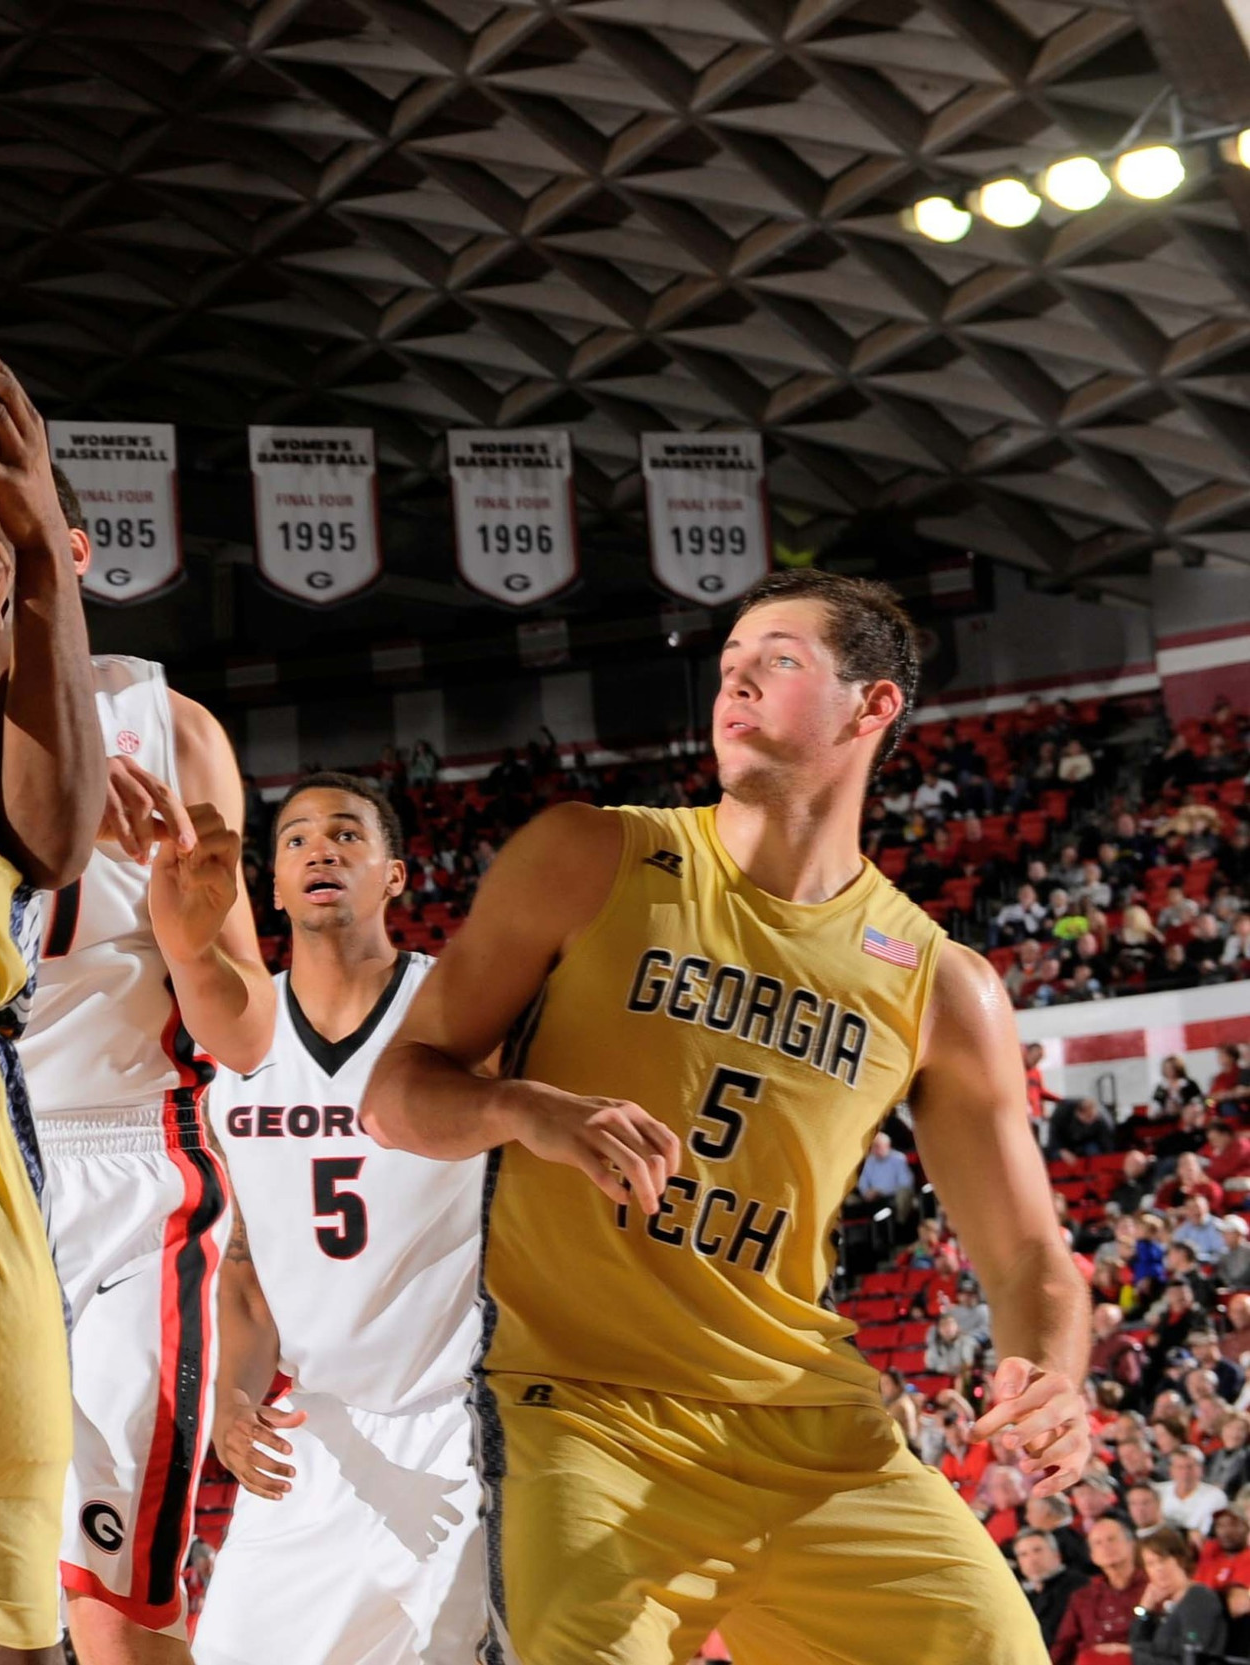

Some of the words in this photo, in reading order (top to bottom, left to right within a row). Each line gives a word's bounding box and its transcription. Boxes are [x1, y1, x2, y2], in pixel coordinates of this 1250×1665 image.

[70, 434, 152, 446] WOMEN'S
[271, 438, 352, 450] WOMEN'S
[55, 449, 168, 462] BASKETBALL
[257, 453, 368, 466] BASKETBALL
[454, 456, 563, 469] BASKETBALL
[117, 490, 153, 503] FOUR
[275, 493, 314, 507] FINAL
[318, 494, 354, 508] FOUR
[474, 496, 511, 510] FINAL
[667, 498, 705, 512] FINAL
[278, 521, 357, 552] 1995
[477, 524, 553, 554] 1996
[671, 525, 747, 556] 1999
[105, 568, 133, 586] G
[305, 571, 334, 589] G
[503, 573, 532, 592] G
[625, 945, 871, 1090] GEORGIA
[686, 1062, 768, 1162] 5
[226, 1104, 371, 1139] GEOR
[310, 1155, 367, 1262] 5
[78, 1499, 125, 1556] G
